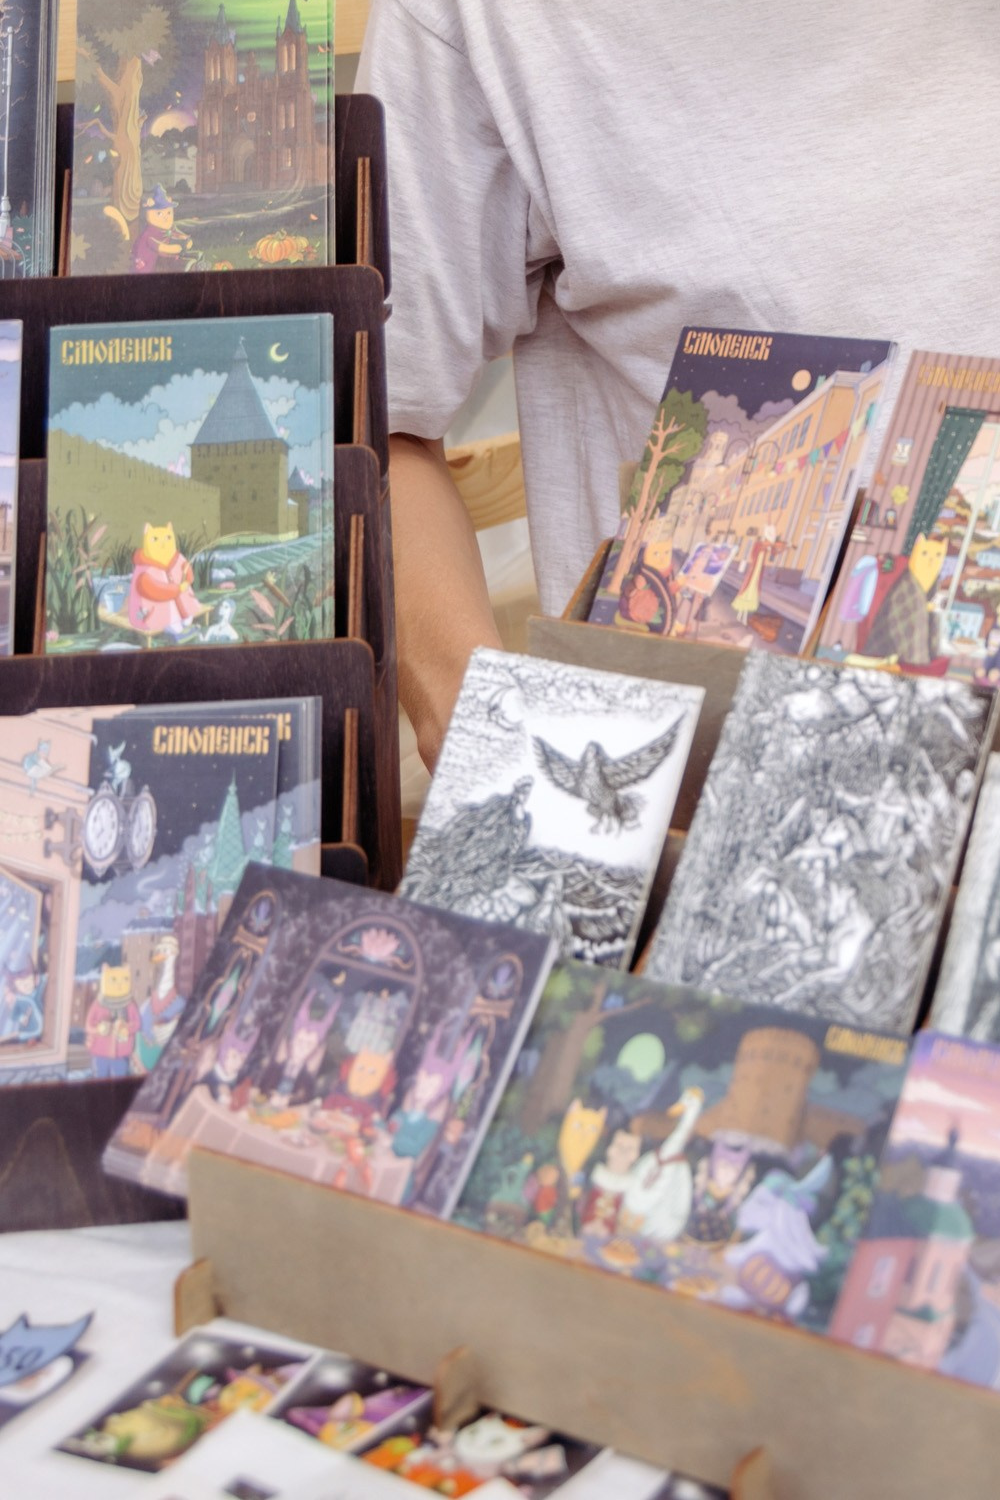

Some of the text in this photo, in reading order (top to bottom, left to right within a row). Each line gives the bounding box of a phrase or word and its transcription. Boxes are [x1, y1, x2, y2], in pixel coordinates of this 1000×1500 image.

[61, 336, 172, 366] СМОЛЕНСК
[683, 329, 773, 361] СМОЛЕНСК
[152, 724, 270, 756] СМОЛЕНСК
